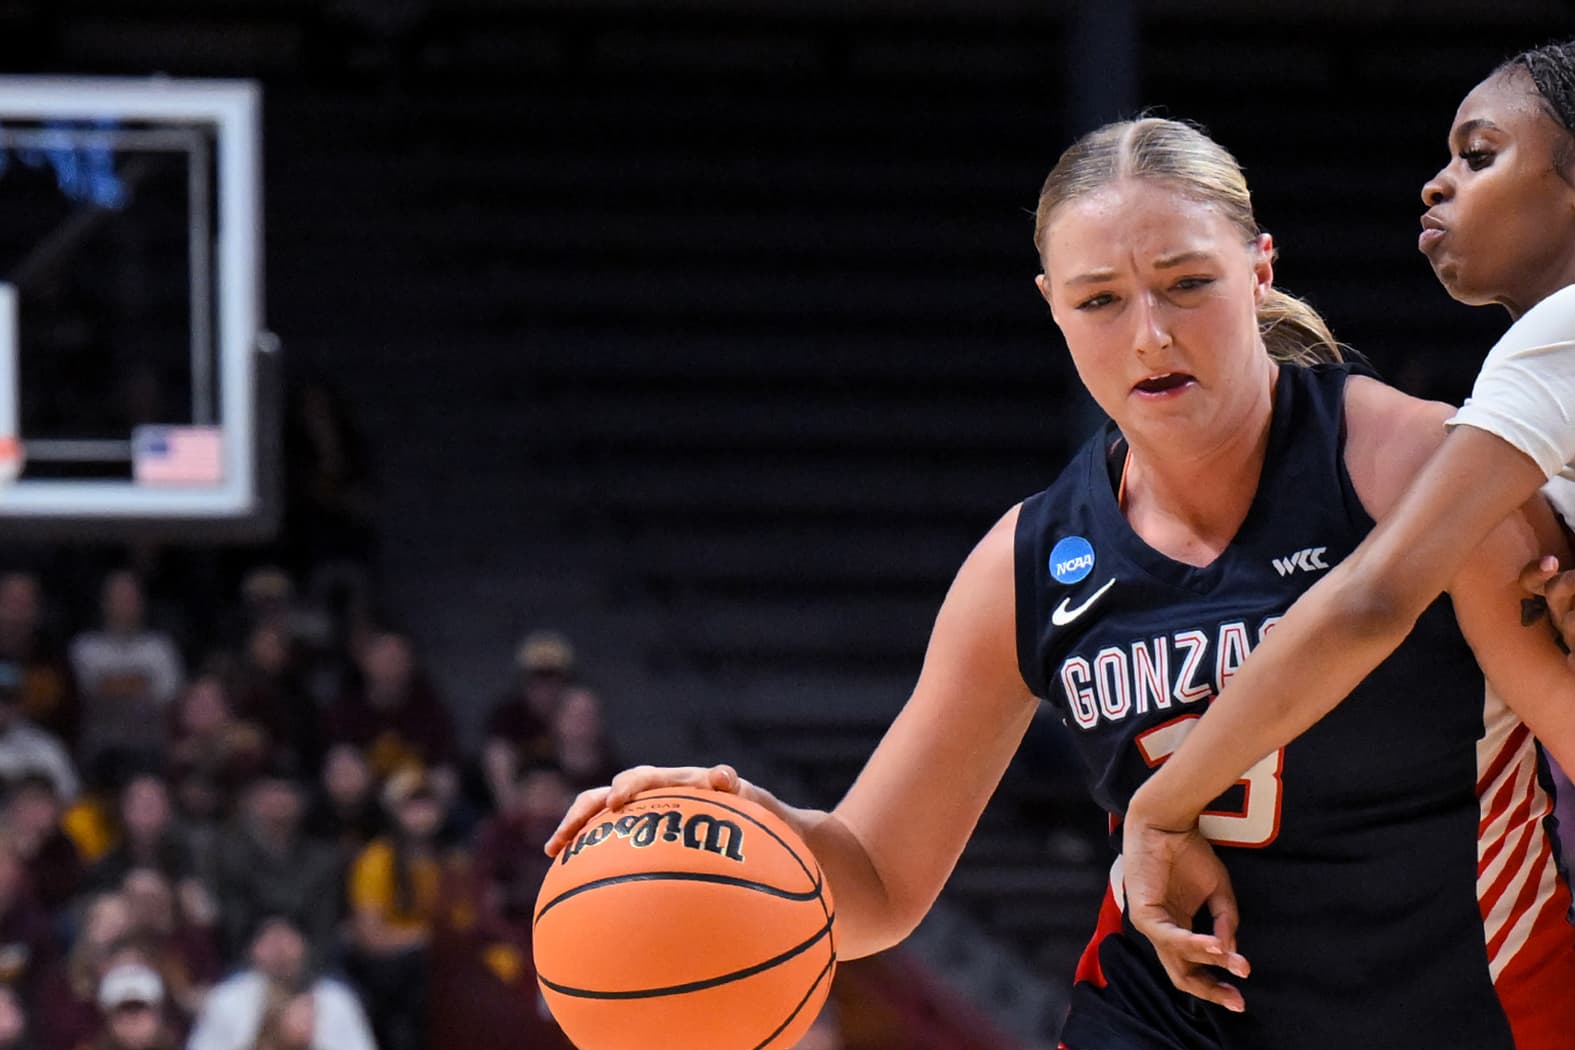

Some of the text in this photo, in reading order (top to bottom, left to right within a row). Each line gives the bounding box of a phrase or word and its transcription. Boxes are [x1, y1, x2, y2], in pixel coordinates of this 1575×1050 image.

[1056, 554, 1092, 576] NCAA
[1272, 547, 1329, 577] WCC
[1061, 617, 1285, 729] GONZA
[561, 811, 745, 865] Wilson
